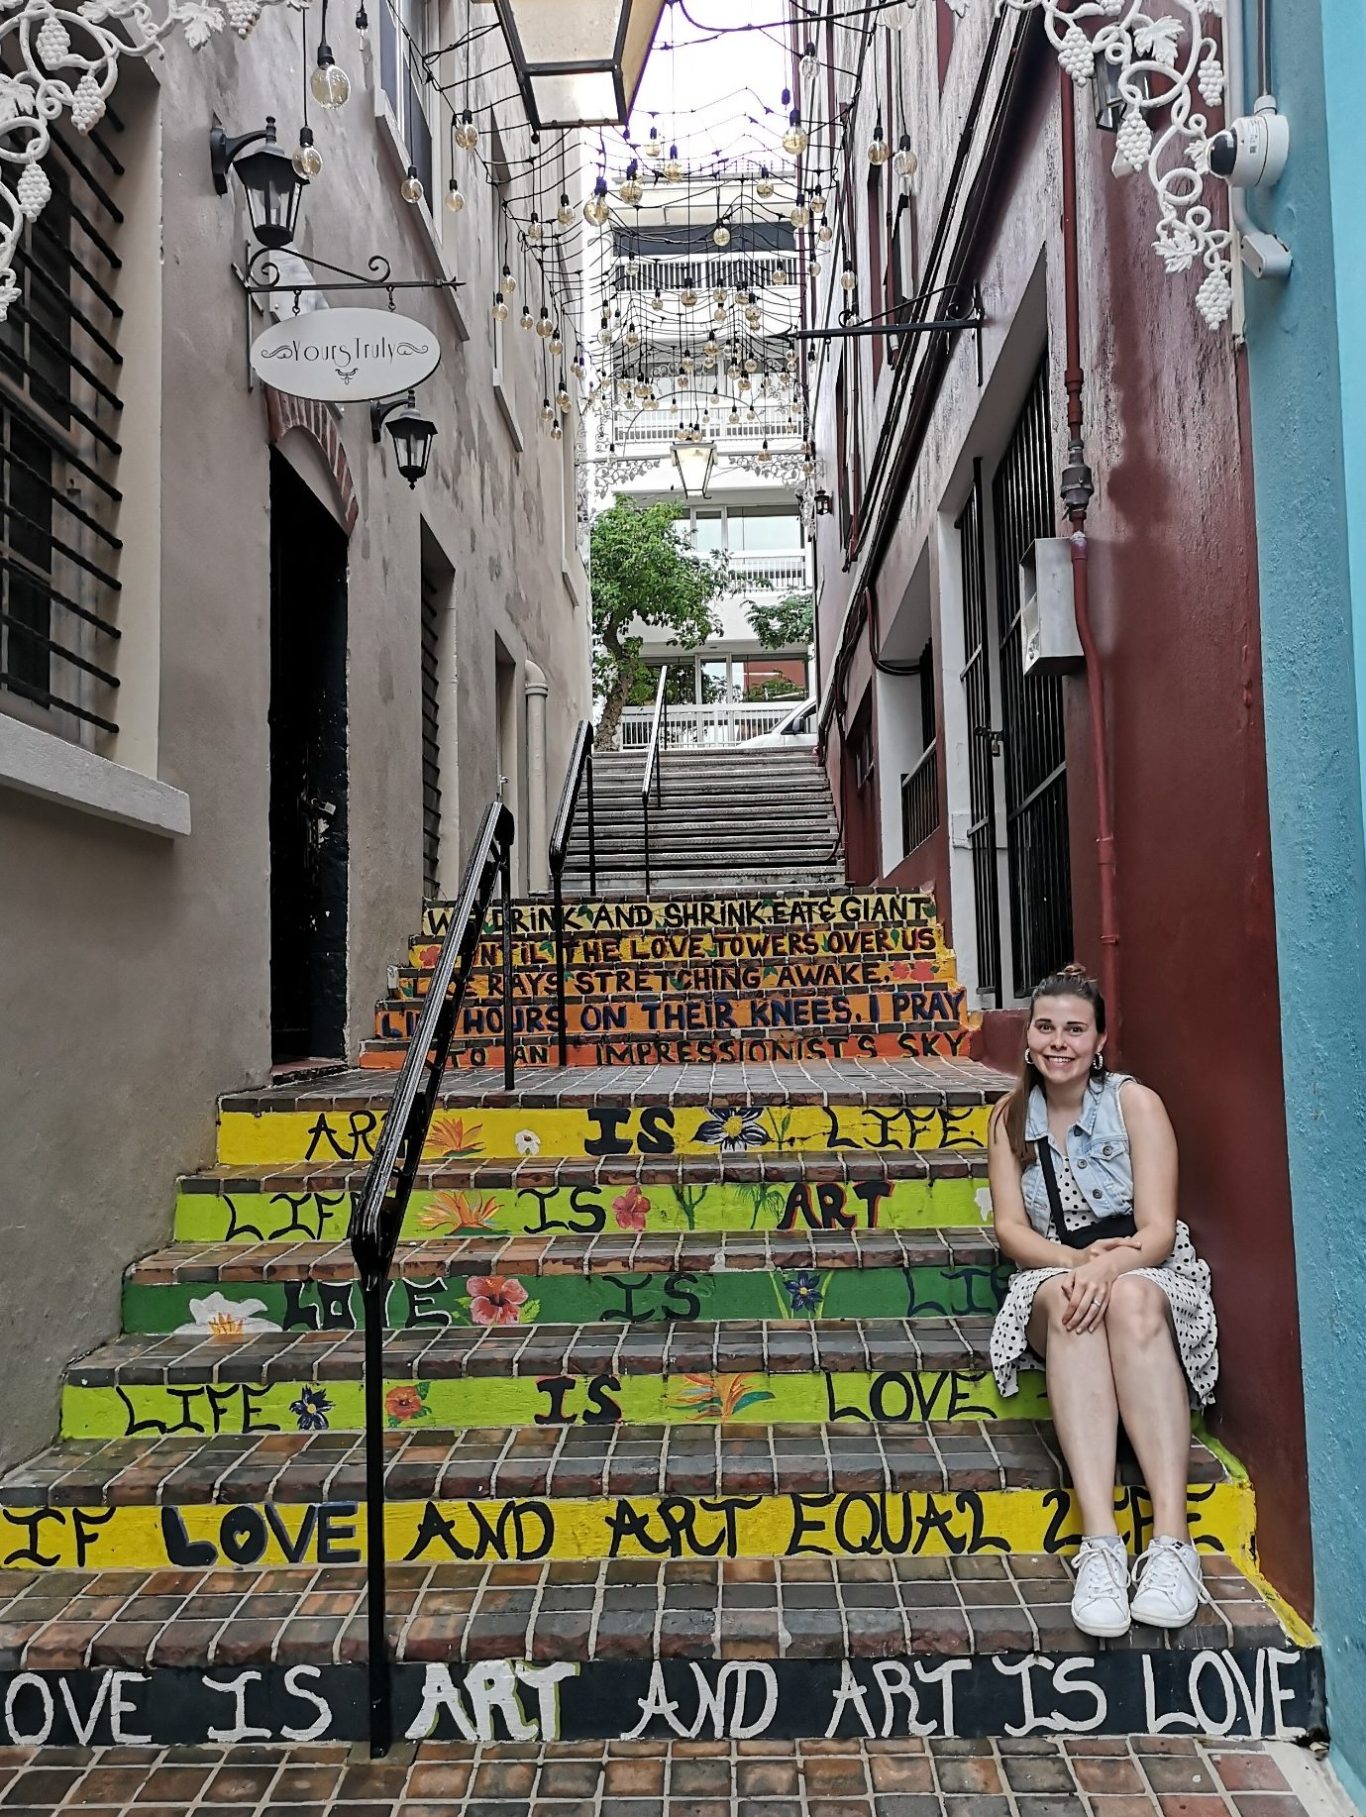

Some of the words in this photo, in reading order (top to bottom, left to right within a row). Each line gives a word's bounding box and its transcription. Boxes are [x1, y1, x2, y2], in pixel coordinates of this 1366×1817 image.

[292, 339, 351, 367] Yours
[353, 336, 398, 363] Truly
[593, 904, 653, 929] AND
[841, 895, 932, 922] GIANT
[562, 937, 621, 964] THE
[629, 934, 706, 960] LOVE
[714, 931, 819, 958] TOWERS
[828, 929, 895, 954] OVER
[902, 928, 937, 951] US
[488, 972, 560, 997] RAYS
[574, 966, 761, 995] STRETCHING
[463, 1004, 567, 1035] HOURS
[580, 1004, 627, 1030] ON
[869, 995, 880, 1023] I
[892, 990, 965, 1021] PRAY
[449, 1047, 487, 1067] TO
[513, 1045, 548, 1065] AN
[898, 1031, 967, 1058] SKY
[584, 1107, 676, 1154] IS
[823, 1106, 984, 1150] LIFE
[517, 1184, 607, 1234] IS
[776, 1181, 894, 1230] ART
[601, 1273, 700, 1322] IS
[115, 1383, 280, 1436] LIFE
[534, 1372, 624, 1425] IS
[825, 1370, 998, 1422] LOVE
[3, 1505, 117, 1567] IF
[161, 1502, 361, 1566] LOVE
[403, 1500, 555, 1562] AND
[604, 1494, 763, 1559] ART
[202, 1664, 333, 1742] IS
[404, 1658, 581, 1741] ART
[620, 1660, 778, 1741] AND
[824, 1658, 972, 1739] ART
[992, 1654, 1107, 1735] IS
[1142, 1648, 1308, 1737] LOVE
